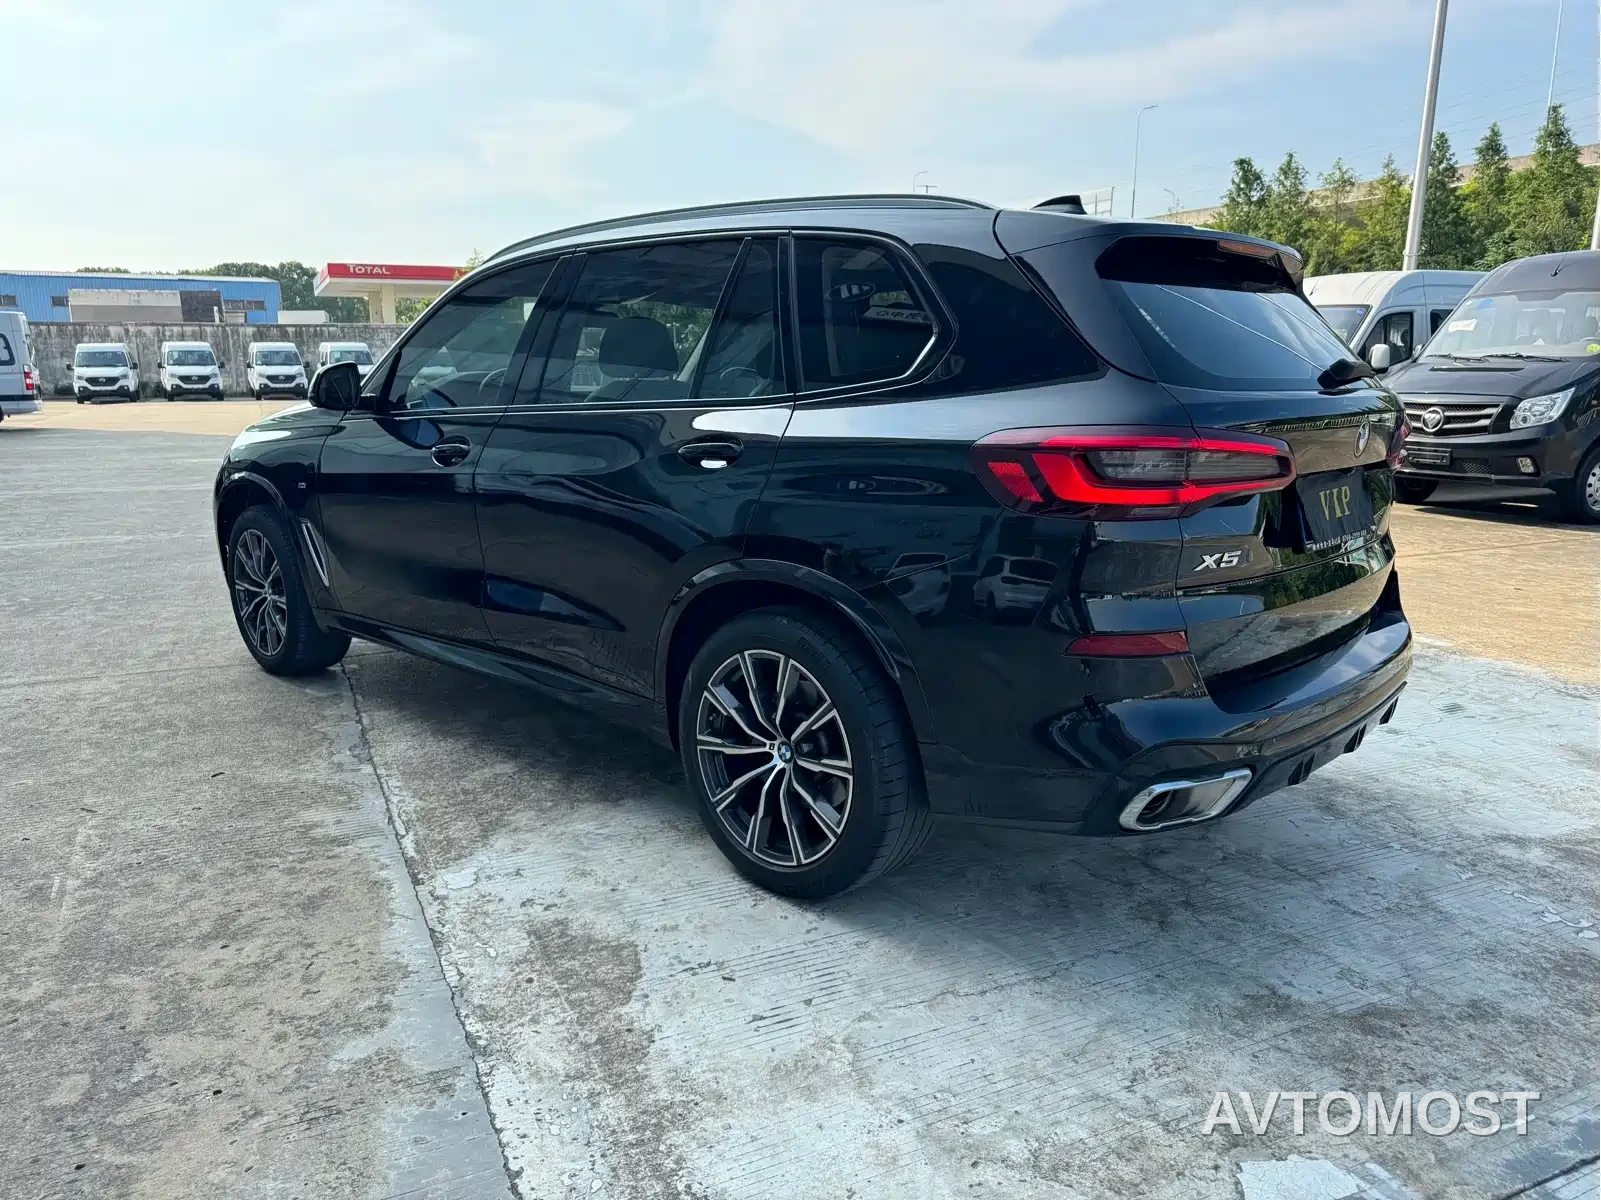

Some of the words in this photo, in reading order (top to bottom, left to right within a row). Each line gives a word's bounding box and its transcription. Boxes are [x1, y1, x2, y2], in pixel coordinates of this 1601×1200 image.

[346, 264, 391, 275] TOTAL
[1318, 485, 1351, 521] VIP
[1193, 550, 1242, 571] X5
